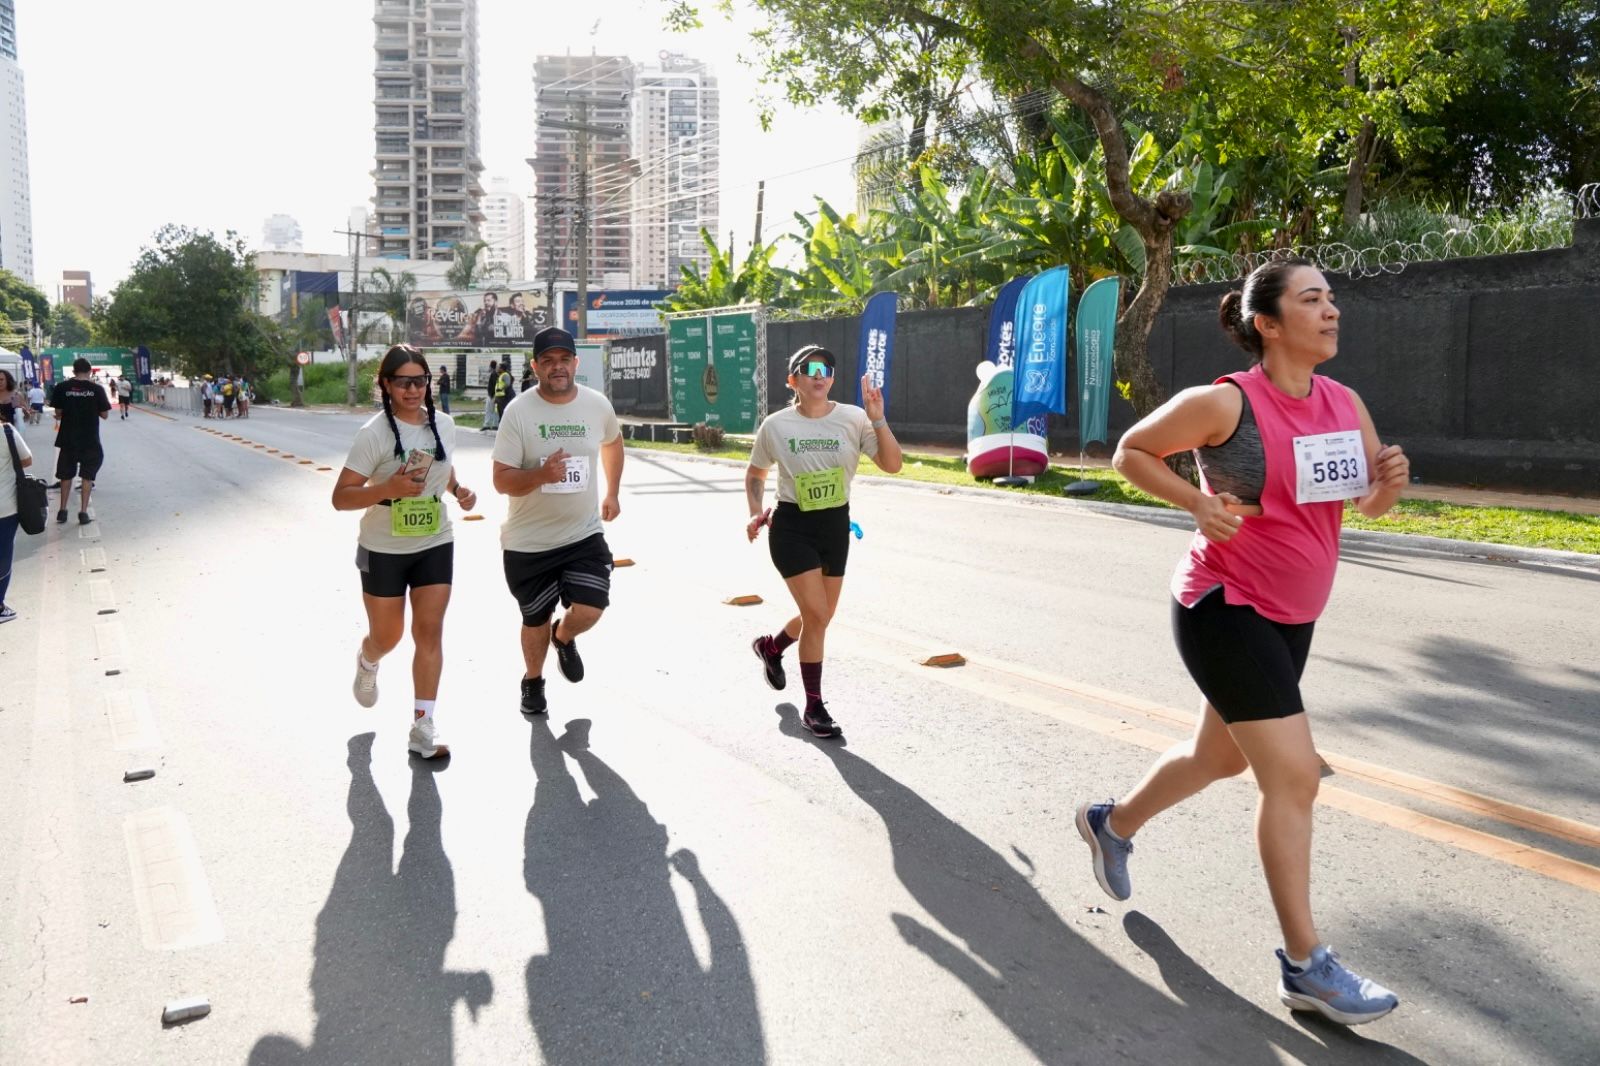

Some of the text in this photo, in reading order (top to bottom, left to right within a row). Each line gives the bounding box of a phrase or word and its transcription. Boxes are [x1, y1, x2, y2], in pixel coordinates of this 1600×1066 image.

[494, 326, 524, 338] GILMAR
[1029, 304, 1046, 362] Encore
[1089, 329, 1097, 386] Neurologia
[65, 390, 95, 398] OPERAÇÃO
[672, 430, 678, 443] 3
[1313, 458, 1358, 483] 5833
[807, 484, 835, 500] 1077
[403, 512, 433, 526] 1025
